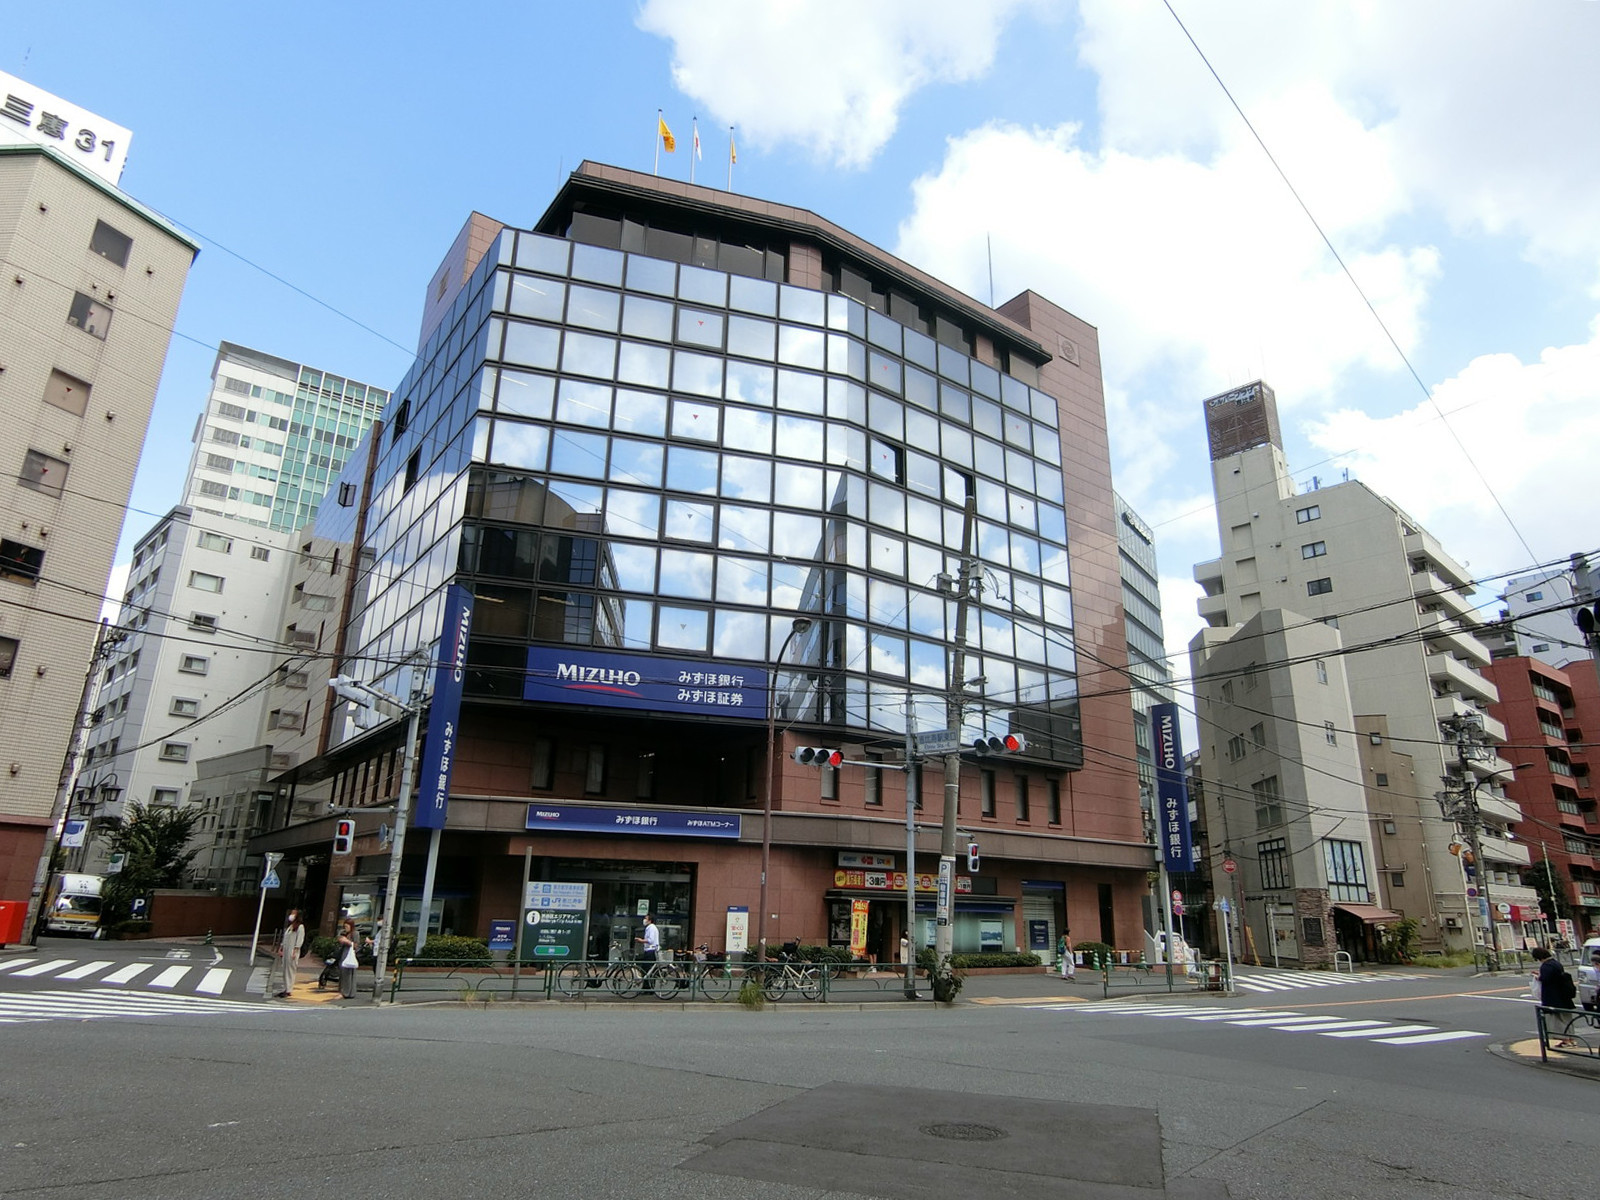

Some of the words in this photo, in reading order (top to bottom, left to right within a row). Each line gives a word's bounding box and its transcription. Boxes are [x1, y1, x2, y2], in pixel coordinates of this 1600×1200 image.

[454, 606, 471, 683] MIZUHO
[556, 663, 641, 687] MIZUHO
[678, 670, 744, 688] みずほ銀行
[677, 688, 743, 706] みずほ証券
[1160, 715, 1175, 769] MIZUHO
[435, 721, 454, 809] みずほ銀行
[615, 815, 658, 826] みずほ銀行
[1166, 797, 1182, 858] みずほ銀行
[134, 899, 144, 910] P
